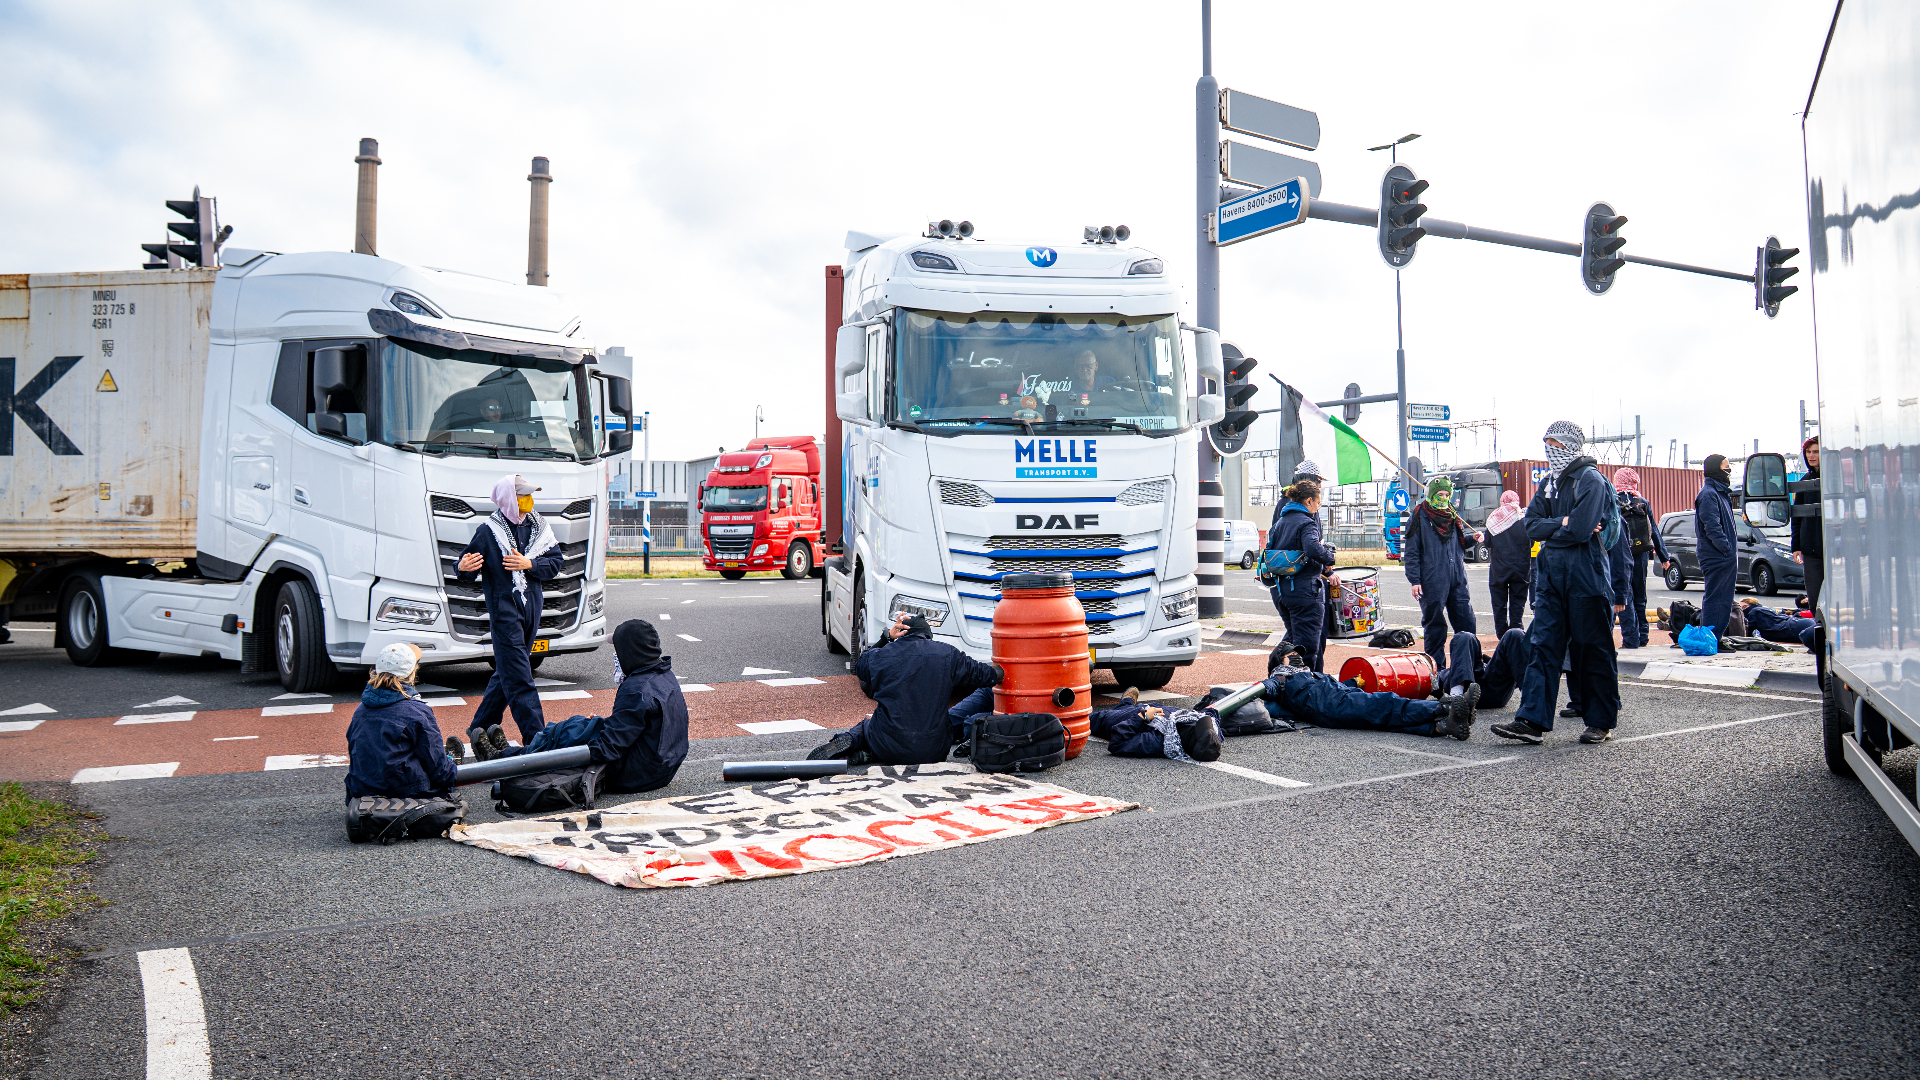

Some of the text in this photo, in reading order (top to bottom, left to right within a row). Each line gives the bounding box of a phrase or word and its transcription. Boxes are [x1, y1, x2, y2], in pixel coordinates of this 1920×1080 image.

[1222, 189, 1287, 219] Havens 8400-8500
[1031, 248, 1051, 262] M
[92, 290, 117, 301] MNBU
[92, 302, 136, 316] 323 725 8
[92, 318, 112, 329] 45R1
[0, 356, 84, 456] K
[1015, 439, 1098, 462] MELLE
[1016, 514, 1099, 530] DAF
